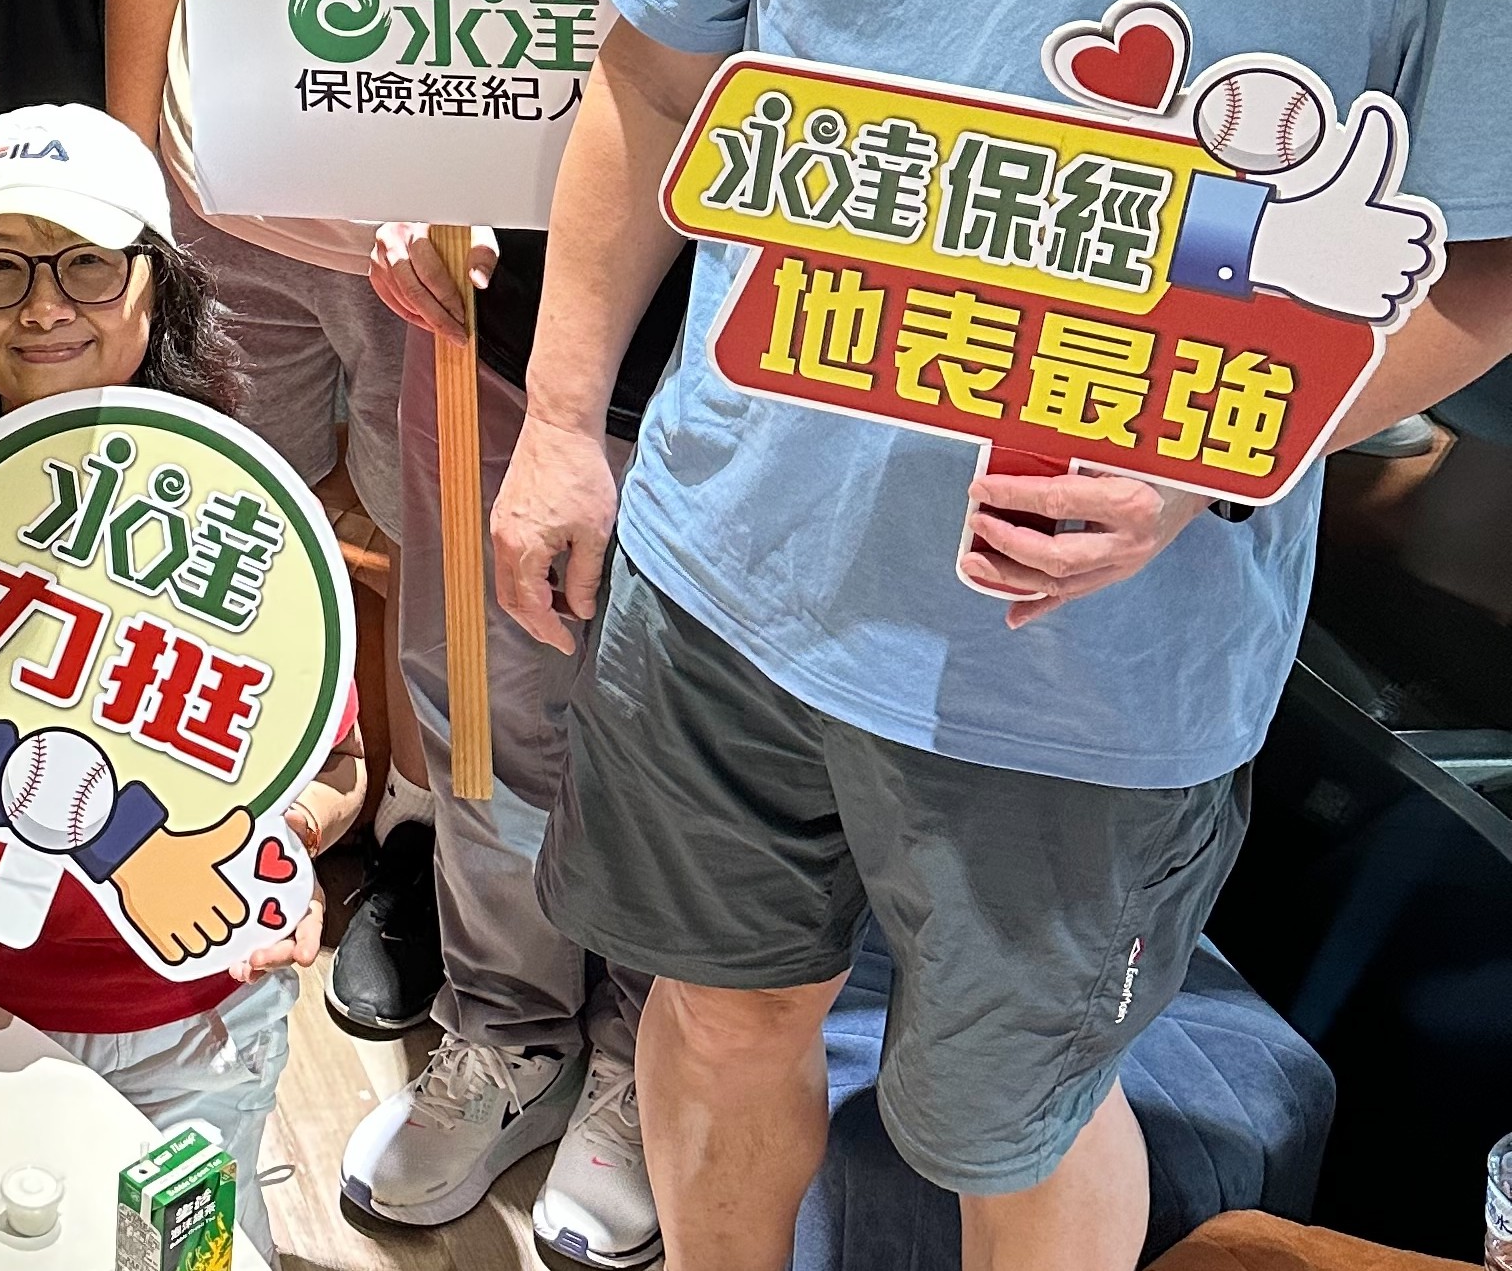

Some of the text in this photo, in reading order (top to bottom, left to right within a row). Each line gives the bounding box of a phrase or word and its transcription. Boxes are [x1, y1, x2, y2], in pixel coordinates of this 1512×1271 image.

[709, 92, 1172, 290] 永達保經
[760, 259, 1298, 478] 地表最強
[22, 433, 285, 630] 永達
